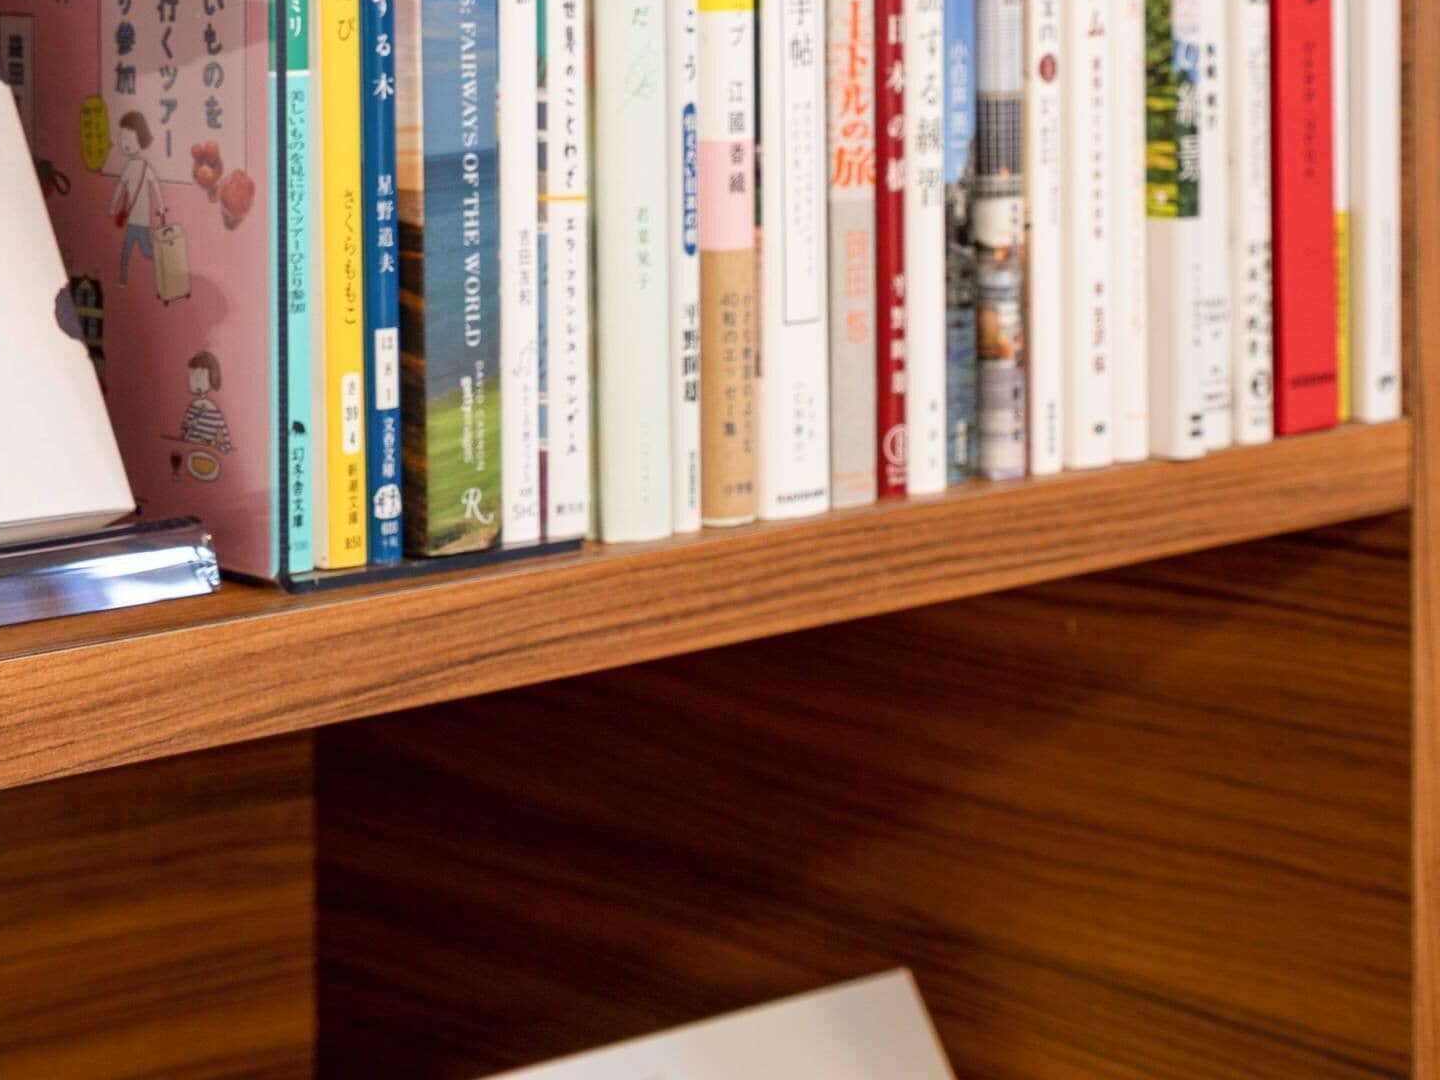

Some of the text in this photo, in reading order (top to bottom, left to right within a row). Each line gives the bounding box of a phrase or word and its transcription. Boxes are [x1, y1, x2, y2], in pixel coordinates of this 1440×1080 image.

[460, 21, 480, 148] FAIRWAYS
[288, 88, 307, 315] 美しいものを見に行くツアーひとり参加
[462, 151, 479, 187] OF
[343, 188, 358, 325] さくらももこ
[375, 173, 396, 274] 星野道夫
[463, 191, 480, 247] THE
[463, 253, 482, 348] WORLD
[291, 447, 306, 528] 幻冬舎文庫
